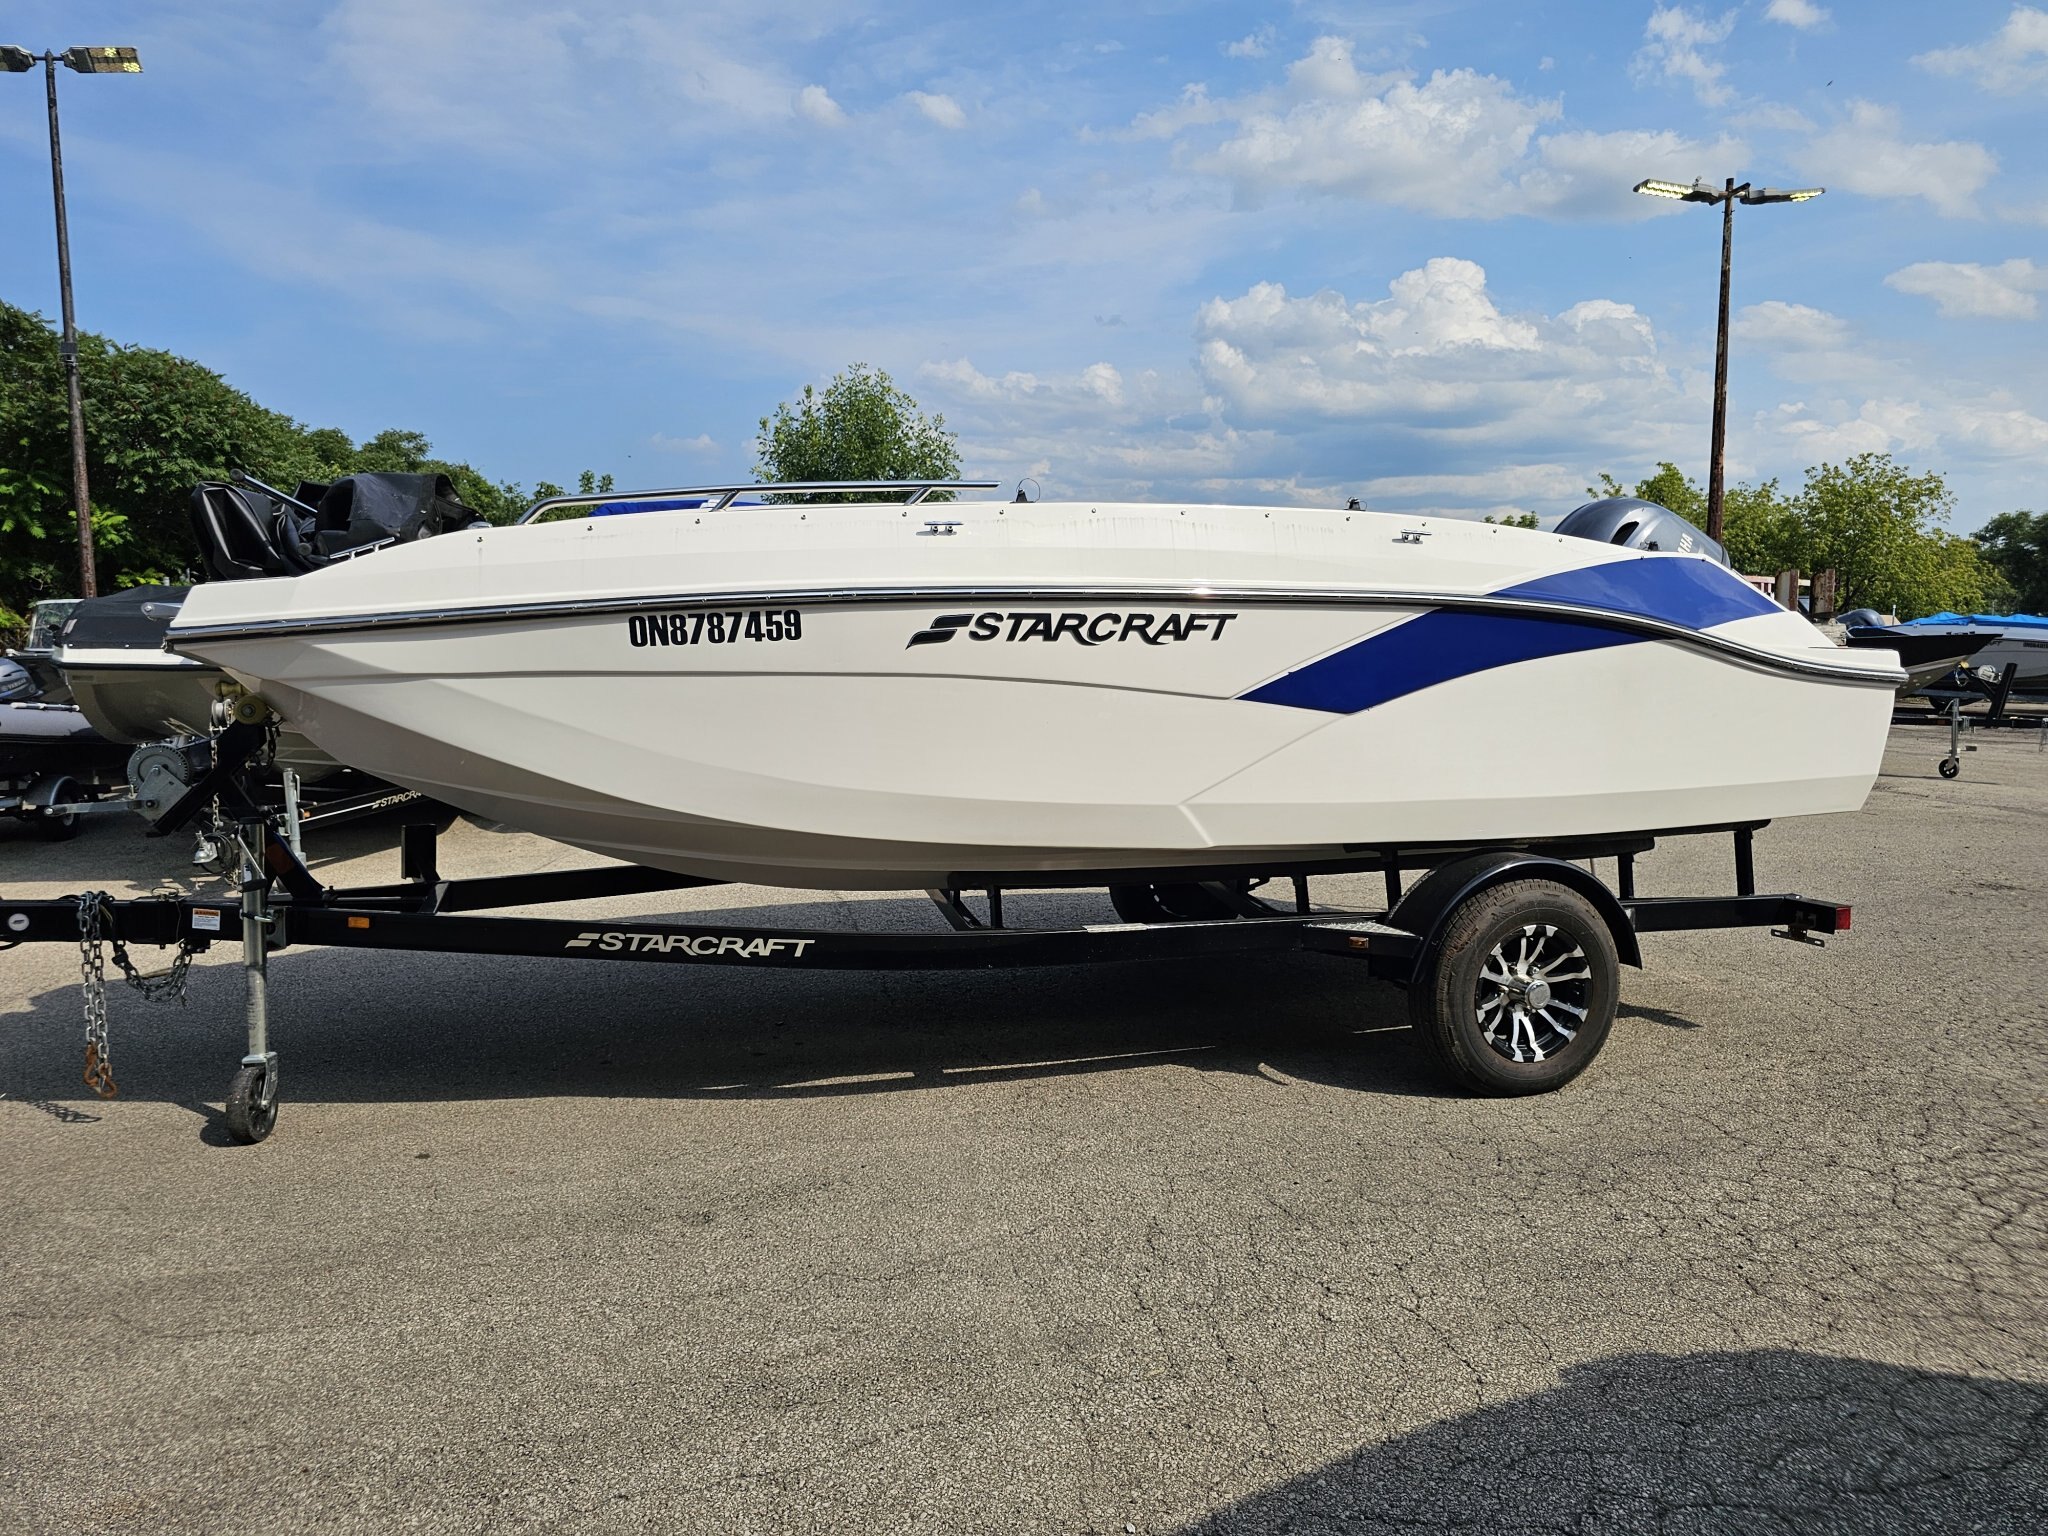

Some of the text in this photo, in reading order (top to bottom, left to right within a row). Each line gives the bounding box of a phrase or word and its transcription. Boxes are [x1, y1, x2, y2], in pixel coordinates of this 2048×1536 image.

[628, 609, 802, 647] ON8787459
[968, 612, 1238, 646] STARCRAFT
[598, 932, 816, 958] STARCRAFT
